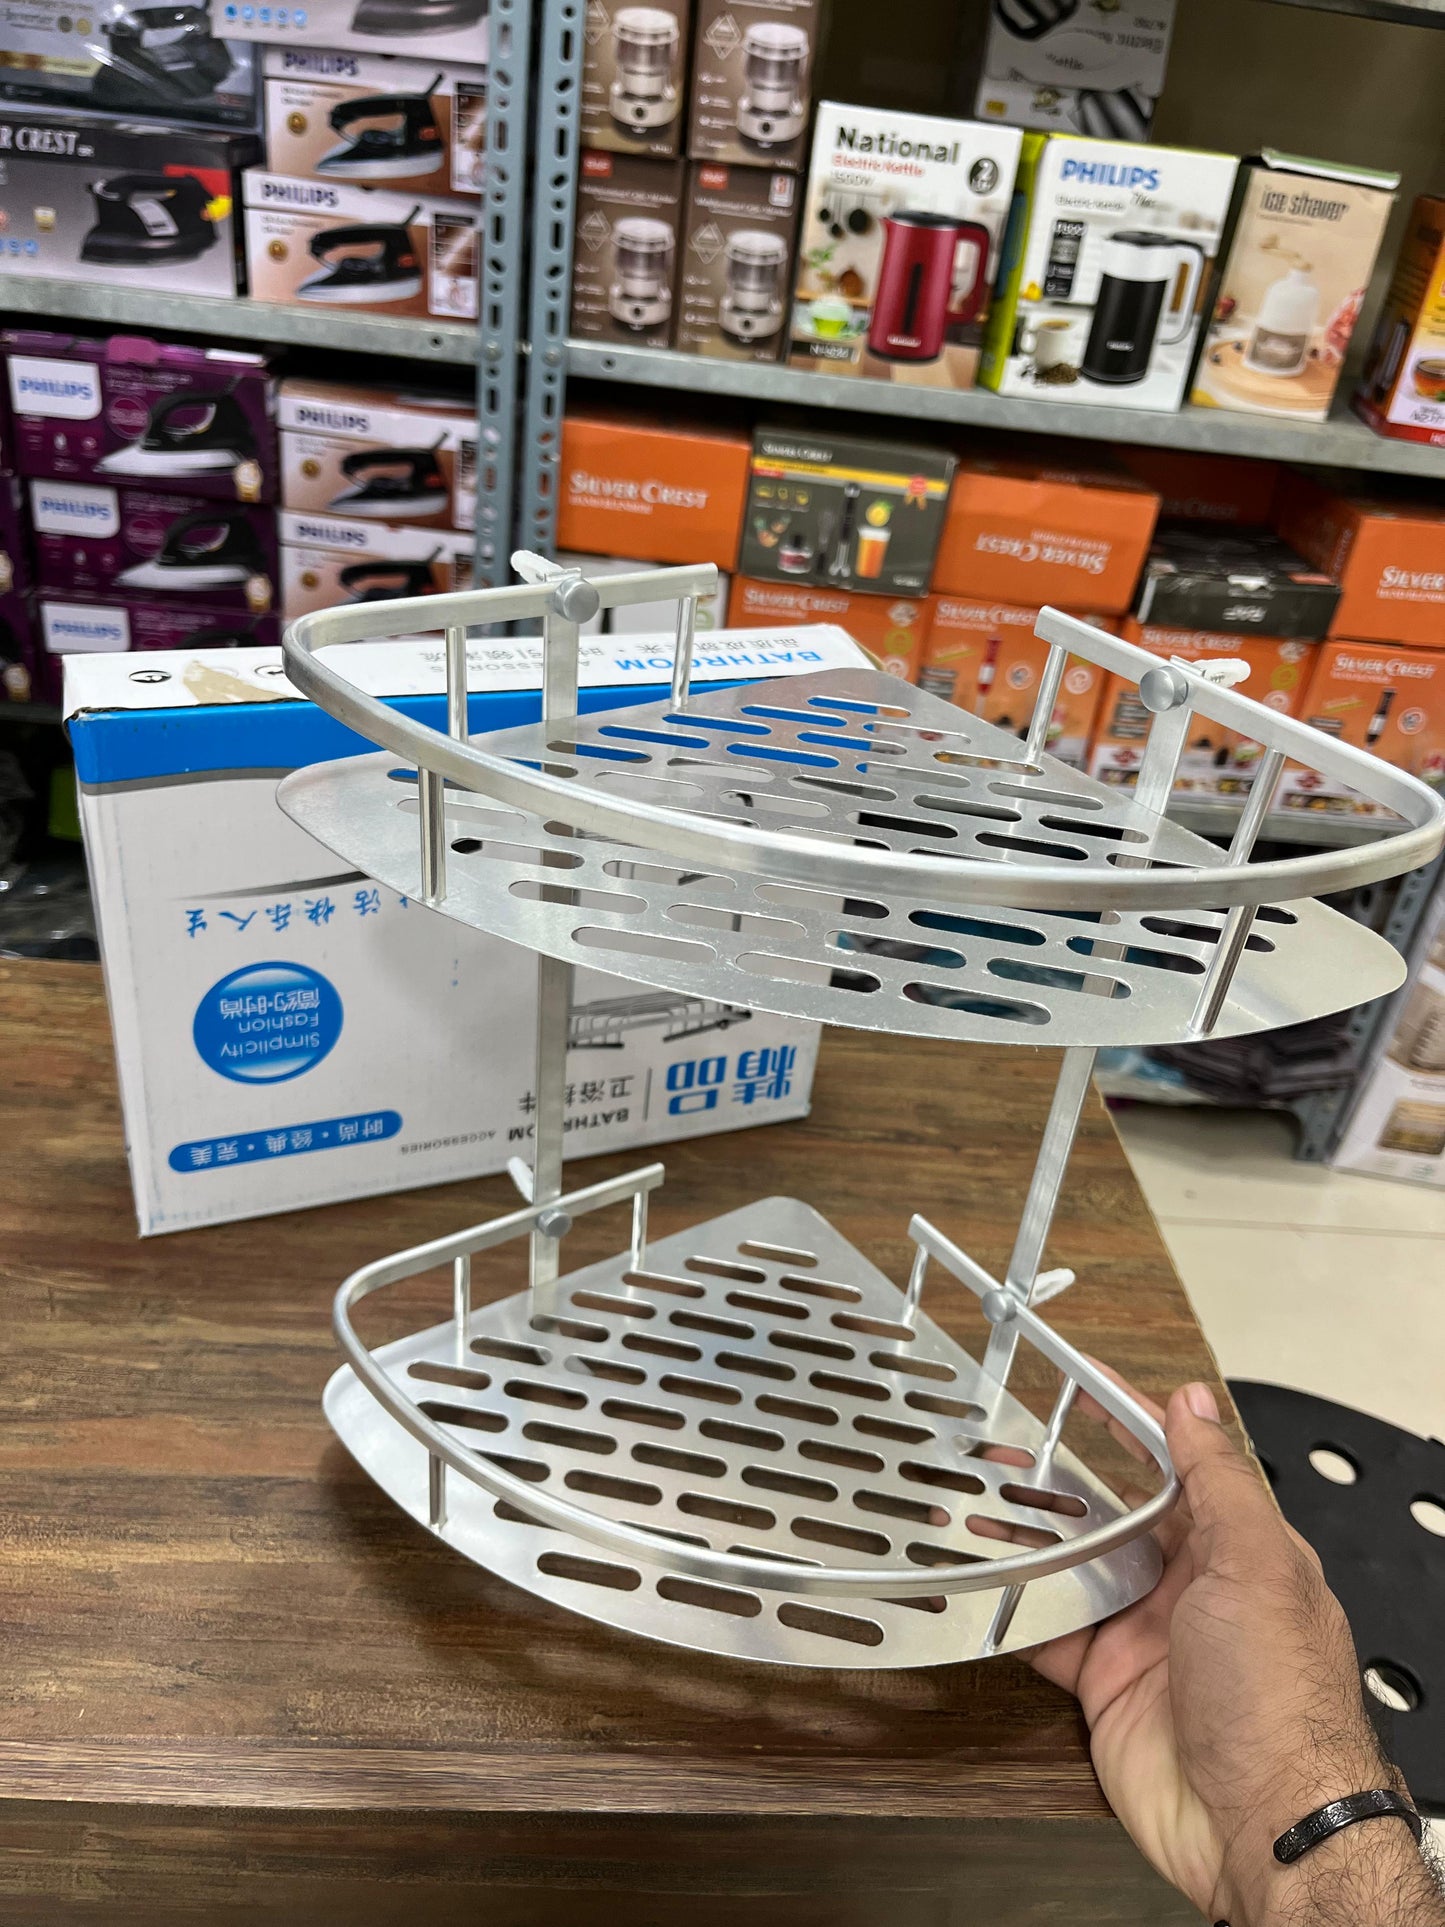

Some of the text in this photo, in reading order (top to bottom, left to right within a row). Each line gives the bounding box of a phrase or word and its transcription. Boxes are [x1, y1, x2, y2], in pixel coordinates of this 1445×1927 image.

[284, 52, 359, 76] PHILIPS
[15, 126, 79, 155] CREST
[836, 126, 960, 165] National
[1061, 159, 1161, 190] PHILIPS
[262, 181, 338, 207] PHILIPS
[297, 408, 369, 432] PHILIPS
[238, 1013, 319, 1034] Fashion
[221, 1032, 320, 1058] Simplicity
[667, 1046, 797, 1116] 精品
[508, 1109, 629, 1139] BATHROM
